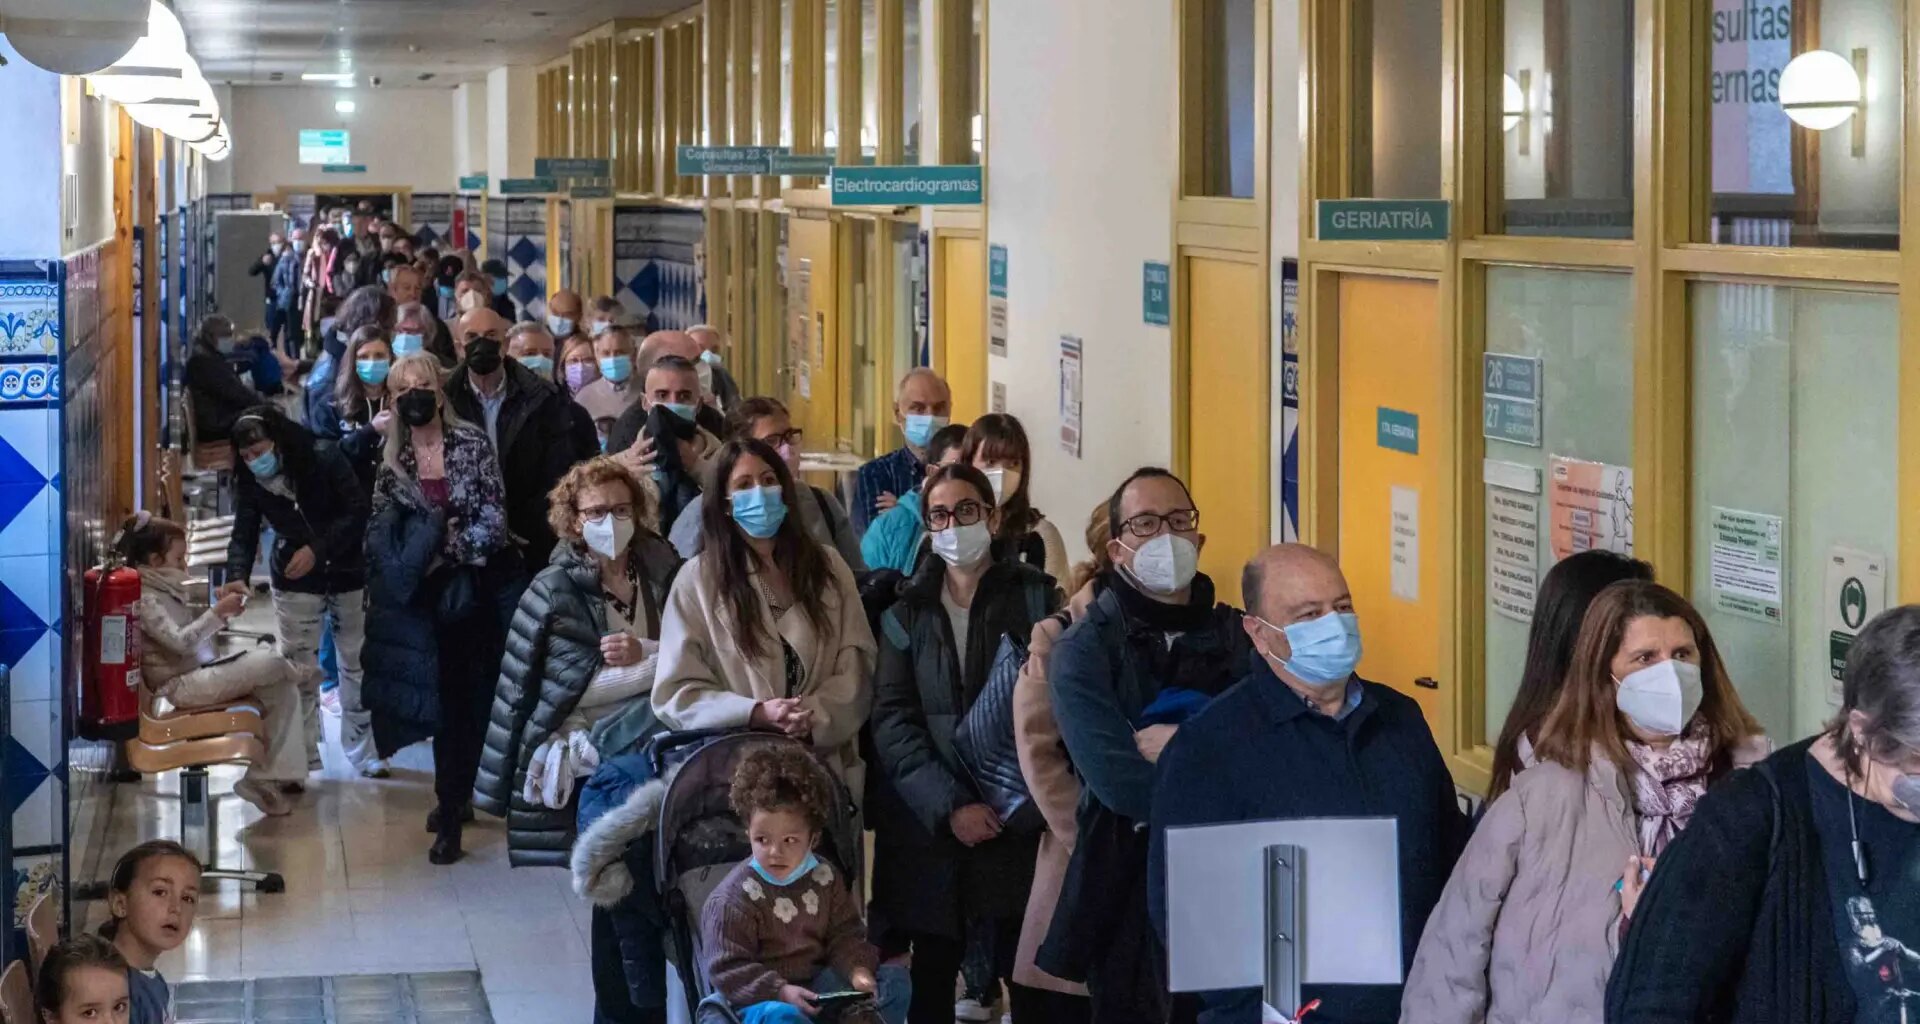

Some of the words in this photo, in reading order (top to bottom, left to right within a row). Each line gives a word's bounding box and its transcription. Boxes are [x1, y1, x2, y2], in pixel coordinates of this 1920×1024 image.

[685, 148, 744, 161] Consultas
[834, 177, 979, 195] Electrocardiogramas
[1332, 207, 1433, 229] GERIATRÍA
[1487, 359, 1503, 389] 26
[1485, 402, 1500, 429] 27
